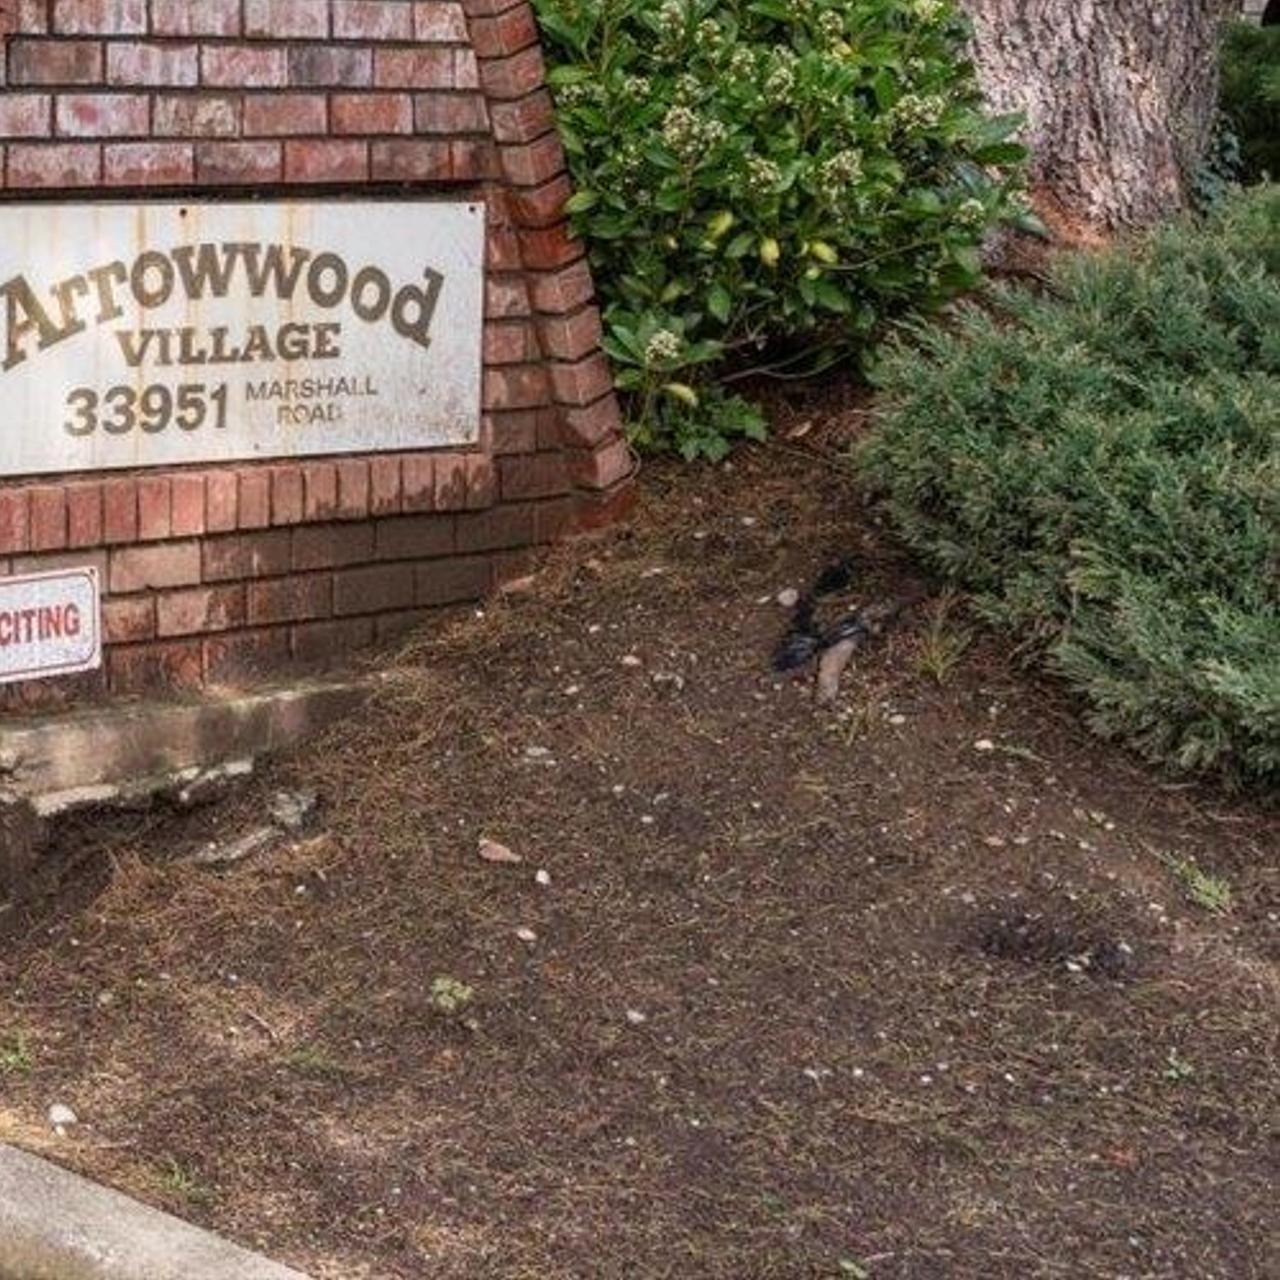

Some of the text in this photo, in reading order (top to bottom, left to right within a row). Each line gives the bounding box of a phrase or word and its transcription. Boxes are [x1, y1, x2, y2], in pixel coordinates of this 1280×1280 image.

[115, 322, 342, 367] VILLAGE
[63, 383, 229, 437] 33951
[244, 375, 378, 401] MARSHALL
